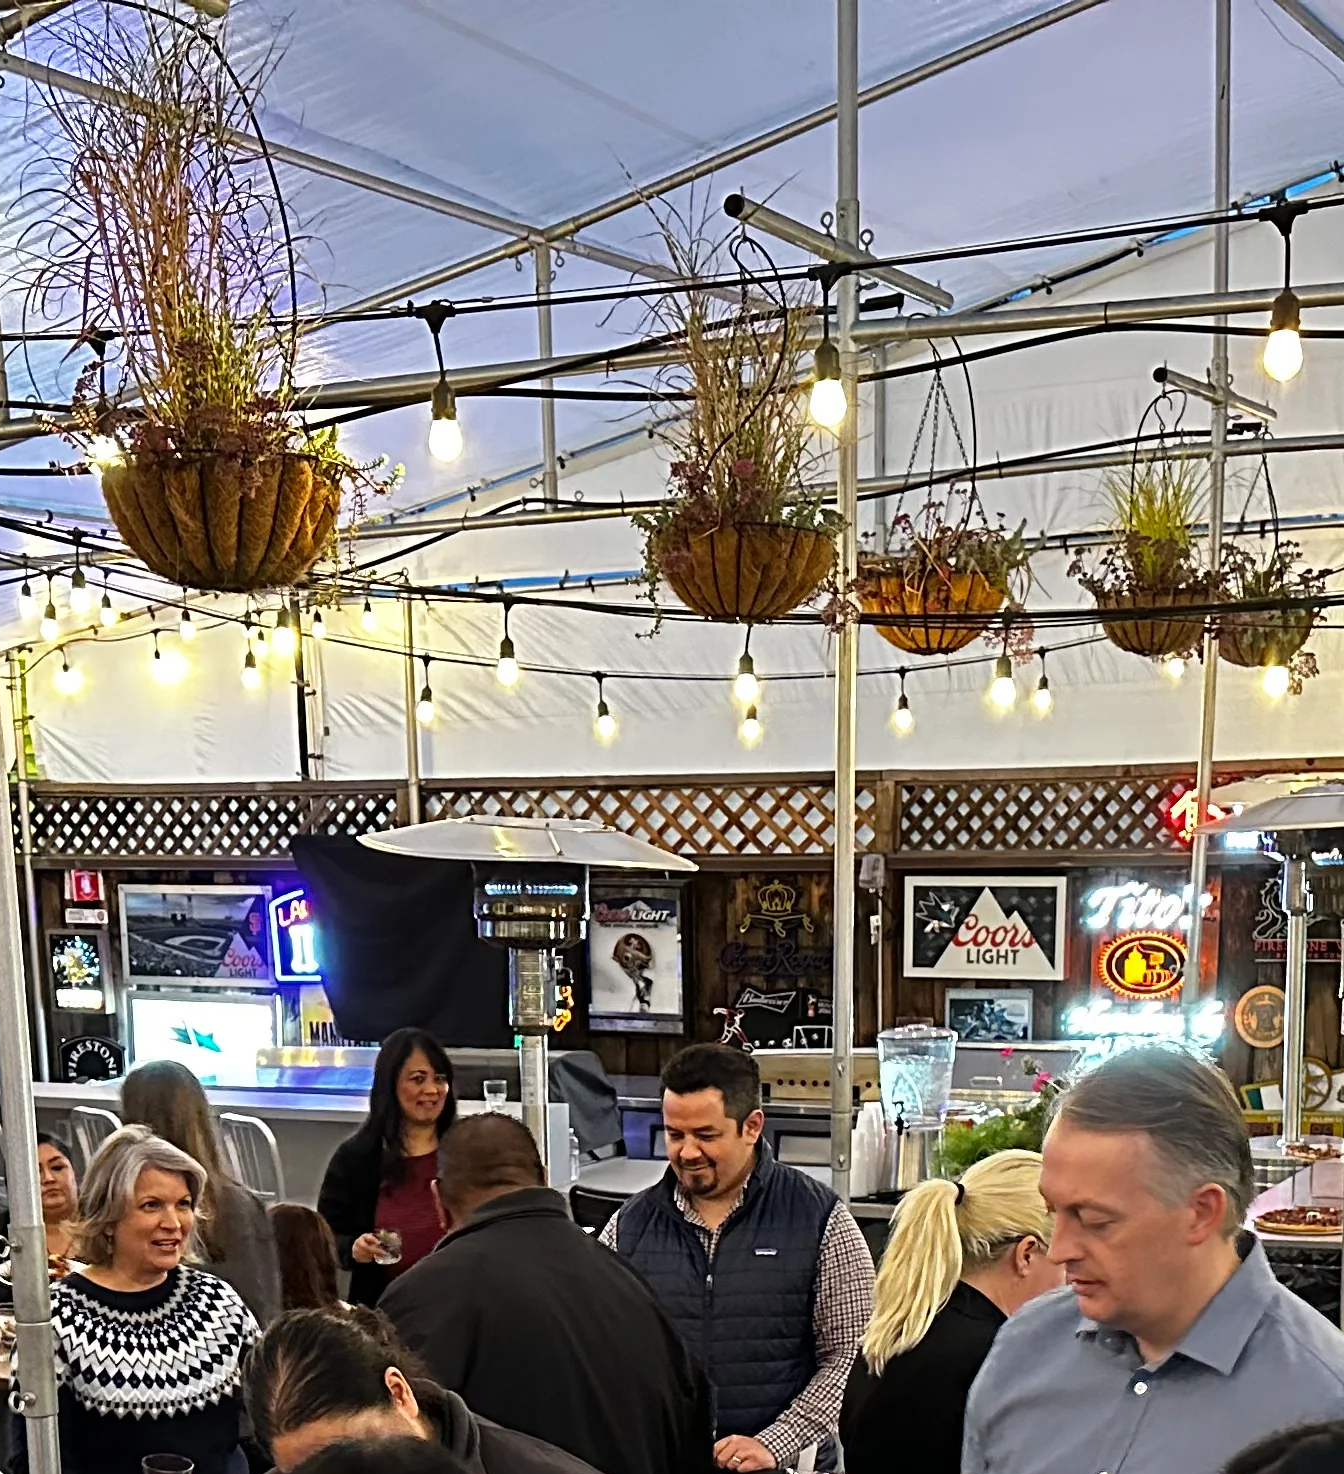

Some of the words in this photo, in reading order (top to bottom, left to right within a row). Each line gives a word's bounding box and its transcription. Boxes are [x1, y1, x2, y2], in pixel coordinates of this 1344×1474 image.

[630, 909, 671, 921] LIGHT
[952, 914, 1037, 948] Coors
[222, 949, 264, 967] Coors
[966, 949, 1020, 965] LIGHT
[229, 967, 257, 979] LIGHT
[68, 1040, 118, 1078] FIRESTONE
